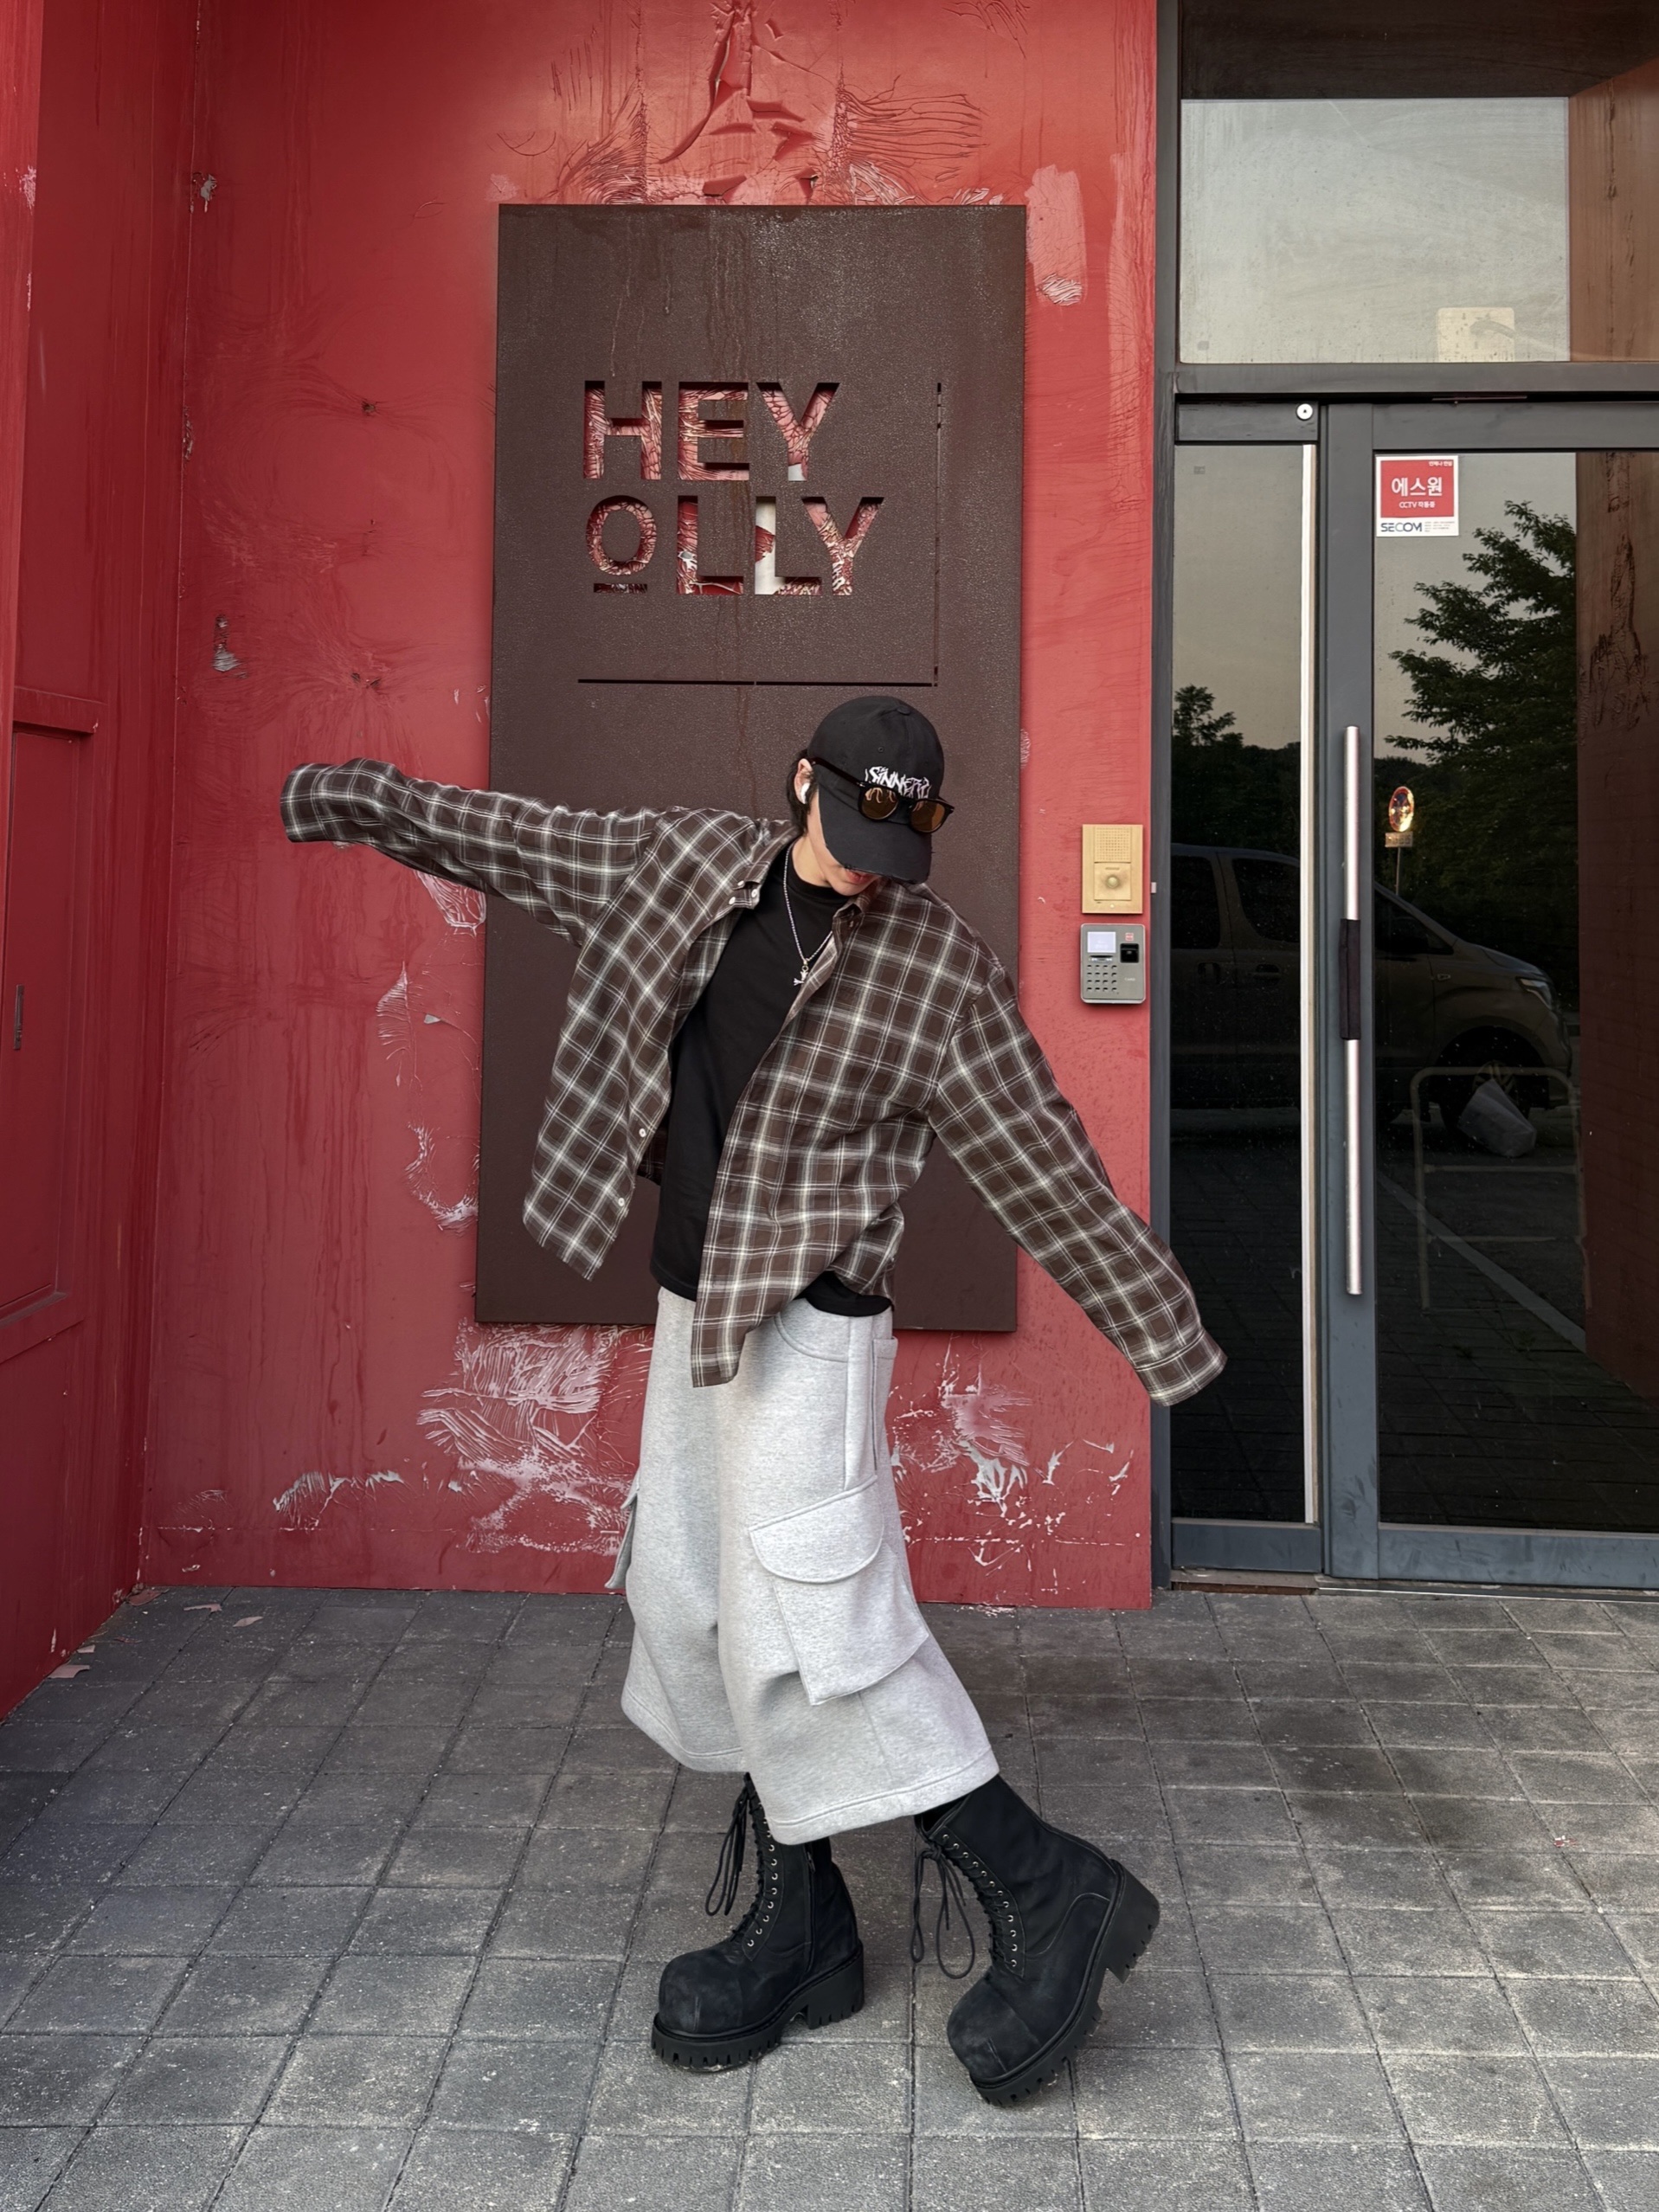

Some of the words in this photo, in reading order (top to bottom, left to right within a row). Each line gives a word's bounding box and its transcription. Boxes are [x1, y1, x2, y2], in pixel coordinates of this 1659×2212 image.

[583, 380, 841, 481] HEY
[1391, 476, 1443, 497] 에스원
[585, 494, 885, 596] OLLY
[1380, 522, 1423, 533] SECOM
